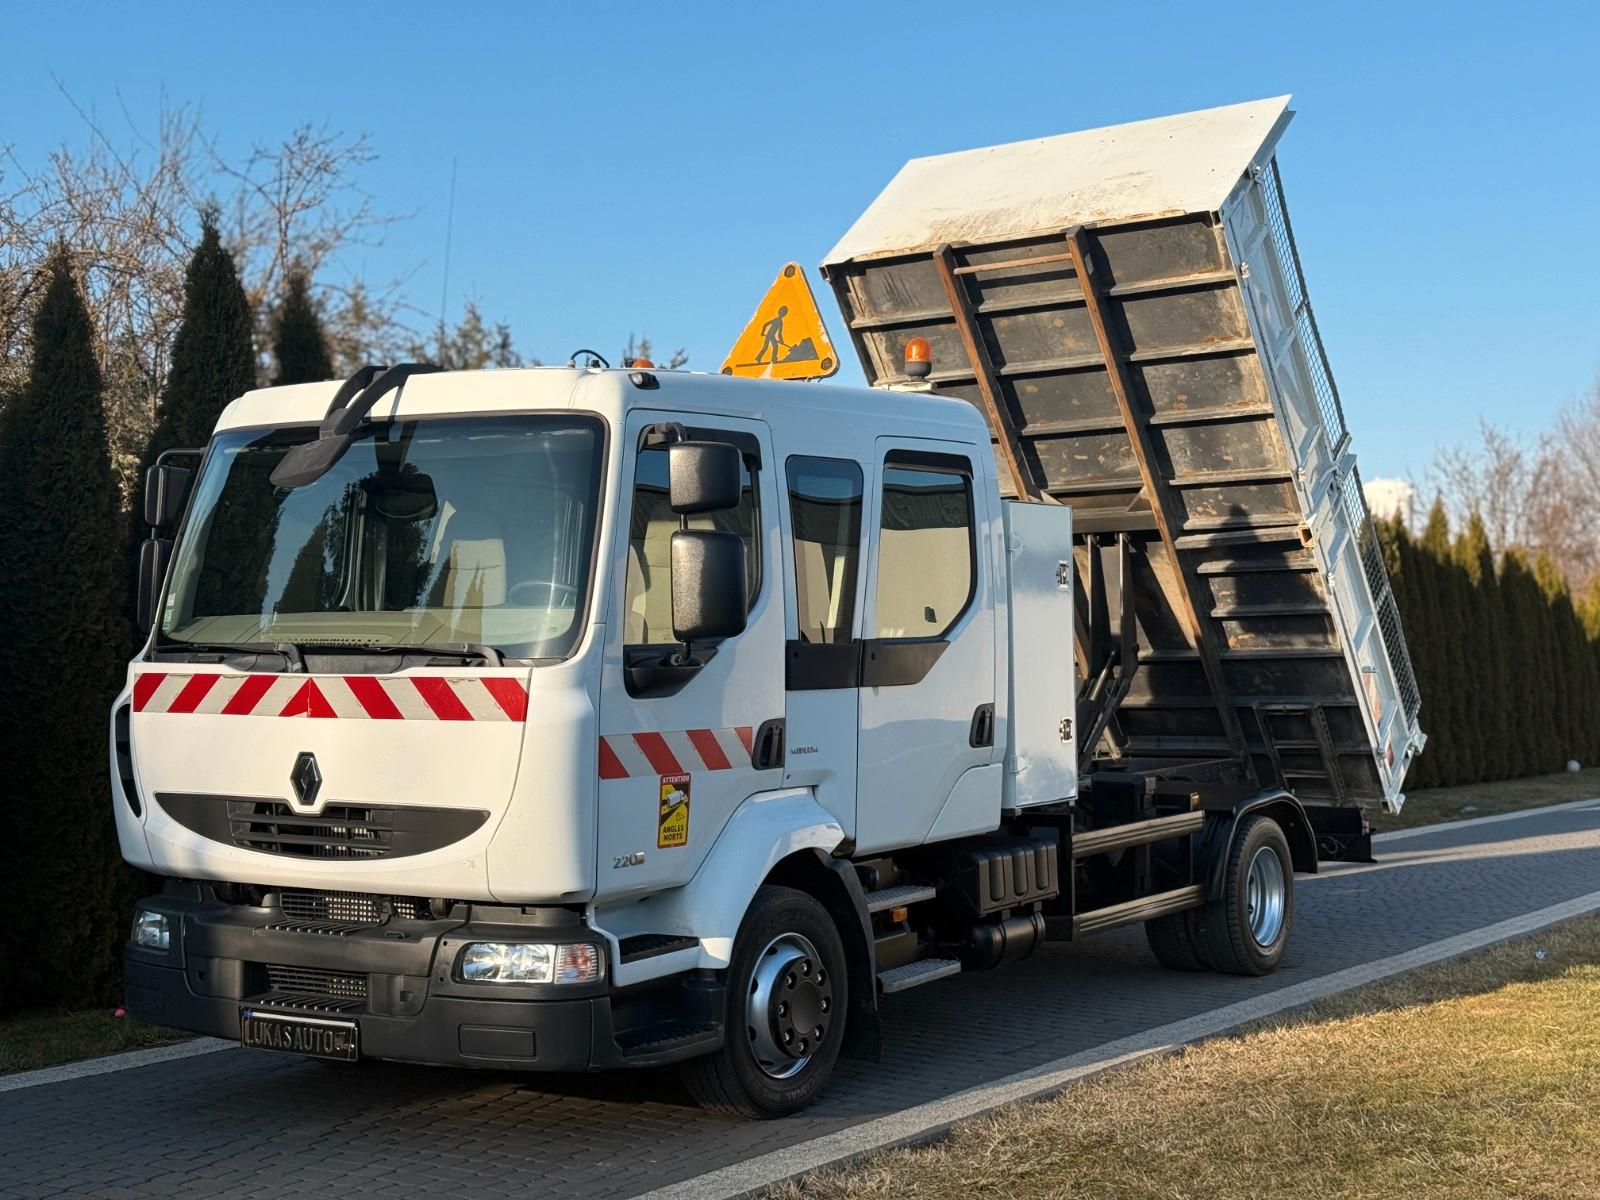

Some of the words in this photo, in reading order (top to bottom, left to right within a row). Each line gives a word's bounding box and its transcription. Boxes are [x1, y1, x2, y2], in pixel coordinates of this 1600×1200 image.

[662, 775, 690, 784] ATTENTION
[663, 824, 684, 833] ANGLES
[663, 832, 683, 841] MORTS
[613, 854, 637, 869] 220
